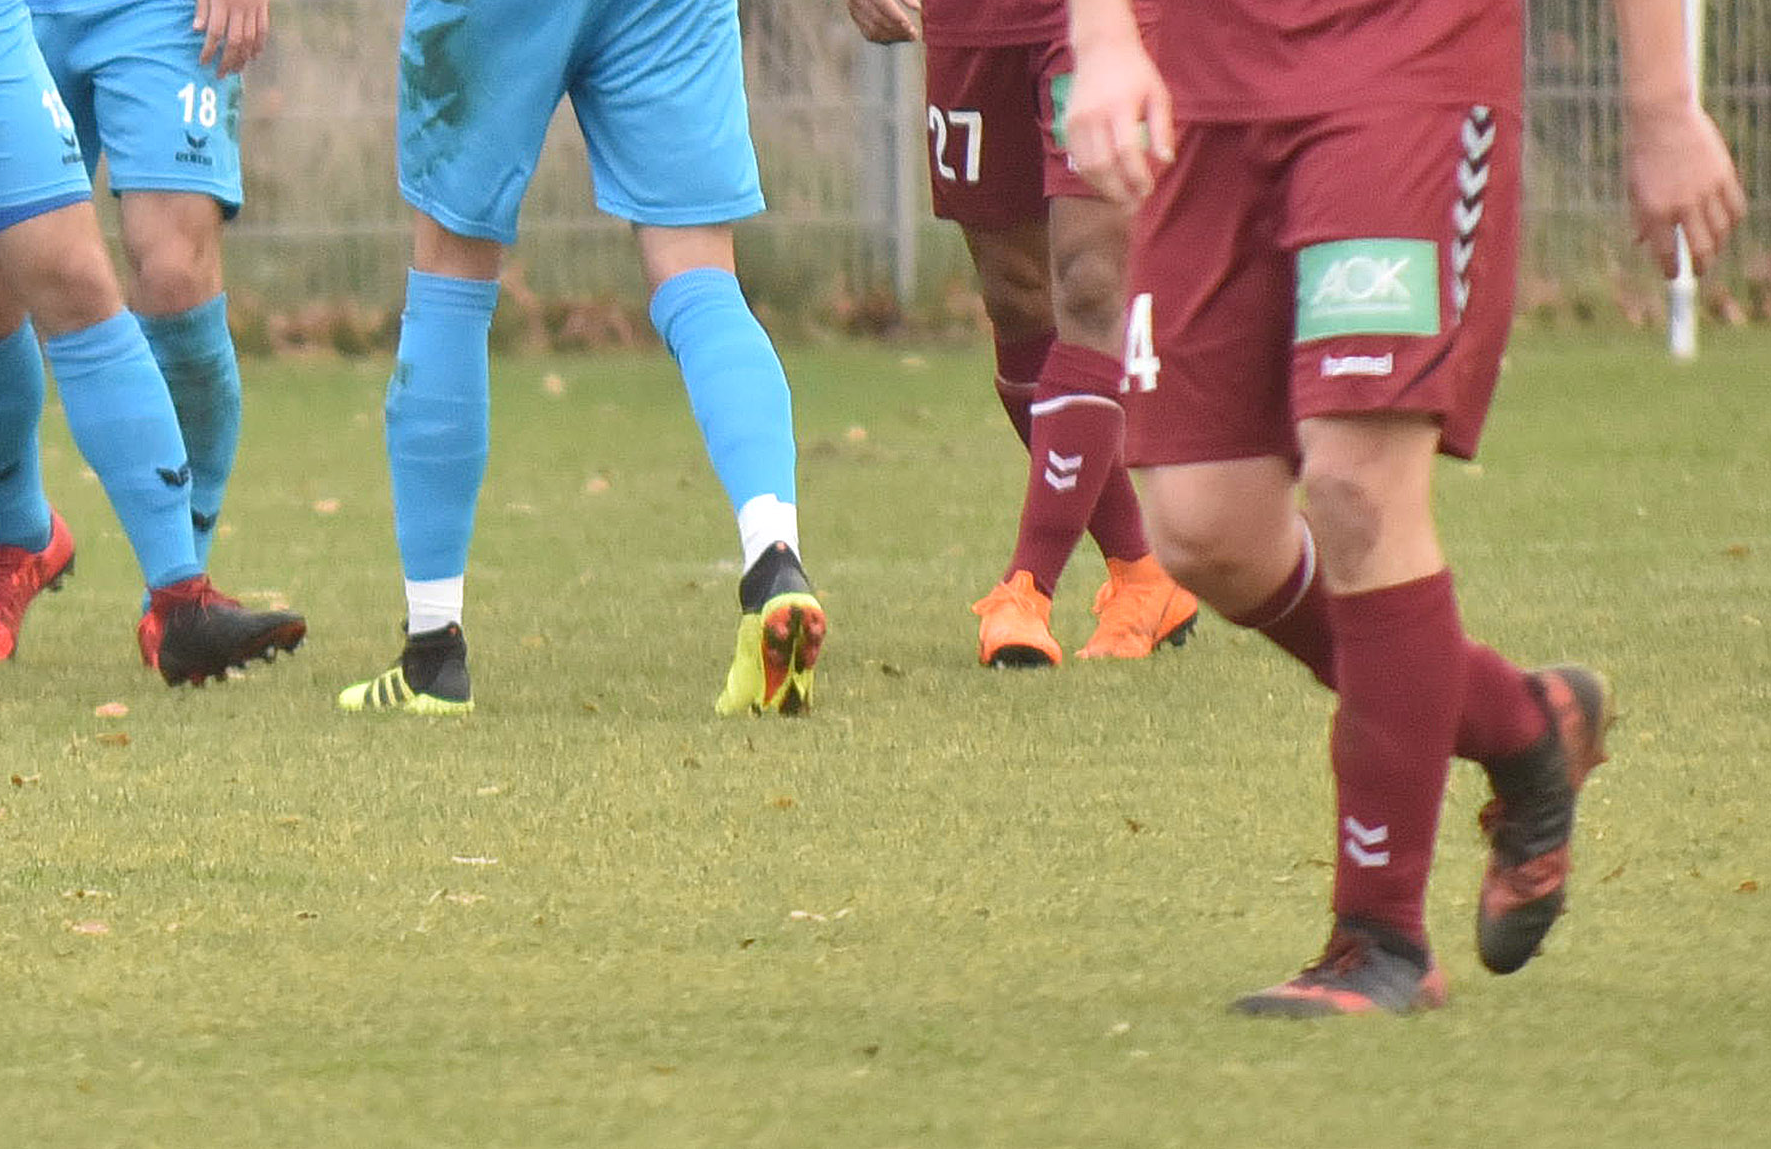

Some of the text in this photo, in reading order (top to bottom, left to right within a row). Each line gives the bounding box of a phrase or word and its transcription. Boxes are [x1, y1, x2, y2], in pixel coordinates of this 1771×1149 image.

[177, 82, 217, 128] 18
[928, 104, 982, 183] 27
[1312, 256, 1412, 306] AOK
